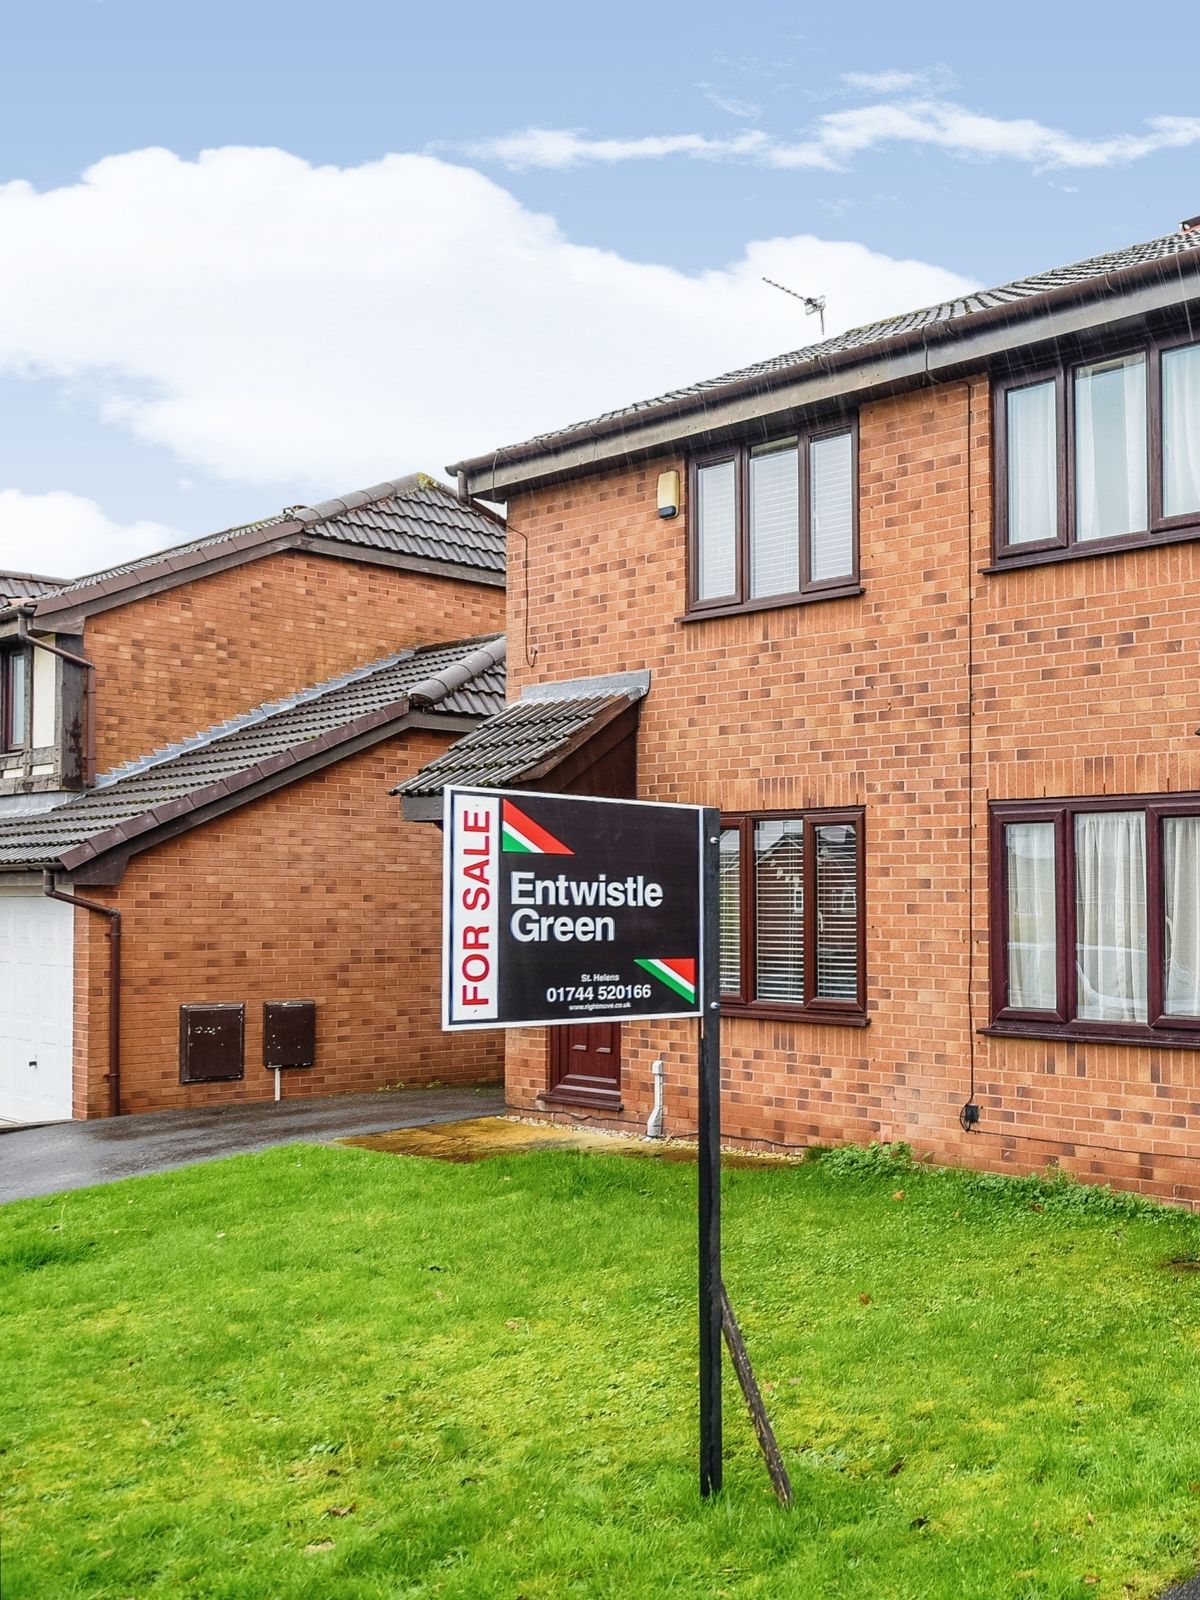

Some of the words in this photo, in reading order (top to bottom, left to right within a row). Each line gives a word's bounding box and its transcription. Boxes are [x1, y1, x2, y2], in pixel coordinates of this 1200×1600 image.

[462, 811, 490, 910] SALE
[510, 871, 664, 906] Entwistle
[510, 908, 615, 942] Green
[462, 925, 489, 1006] FOR
[581, 974, 592, 982] St.
[593, 973, 620, 982] Helens
[546, 986, 594, 1002] 01744
[598, 984, 652, 1000] 520166
[569, 1002, 632, 1011] www.rightmove.co.uk
